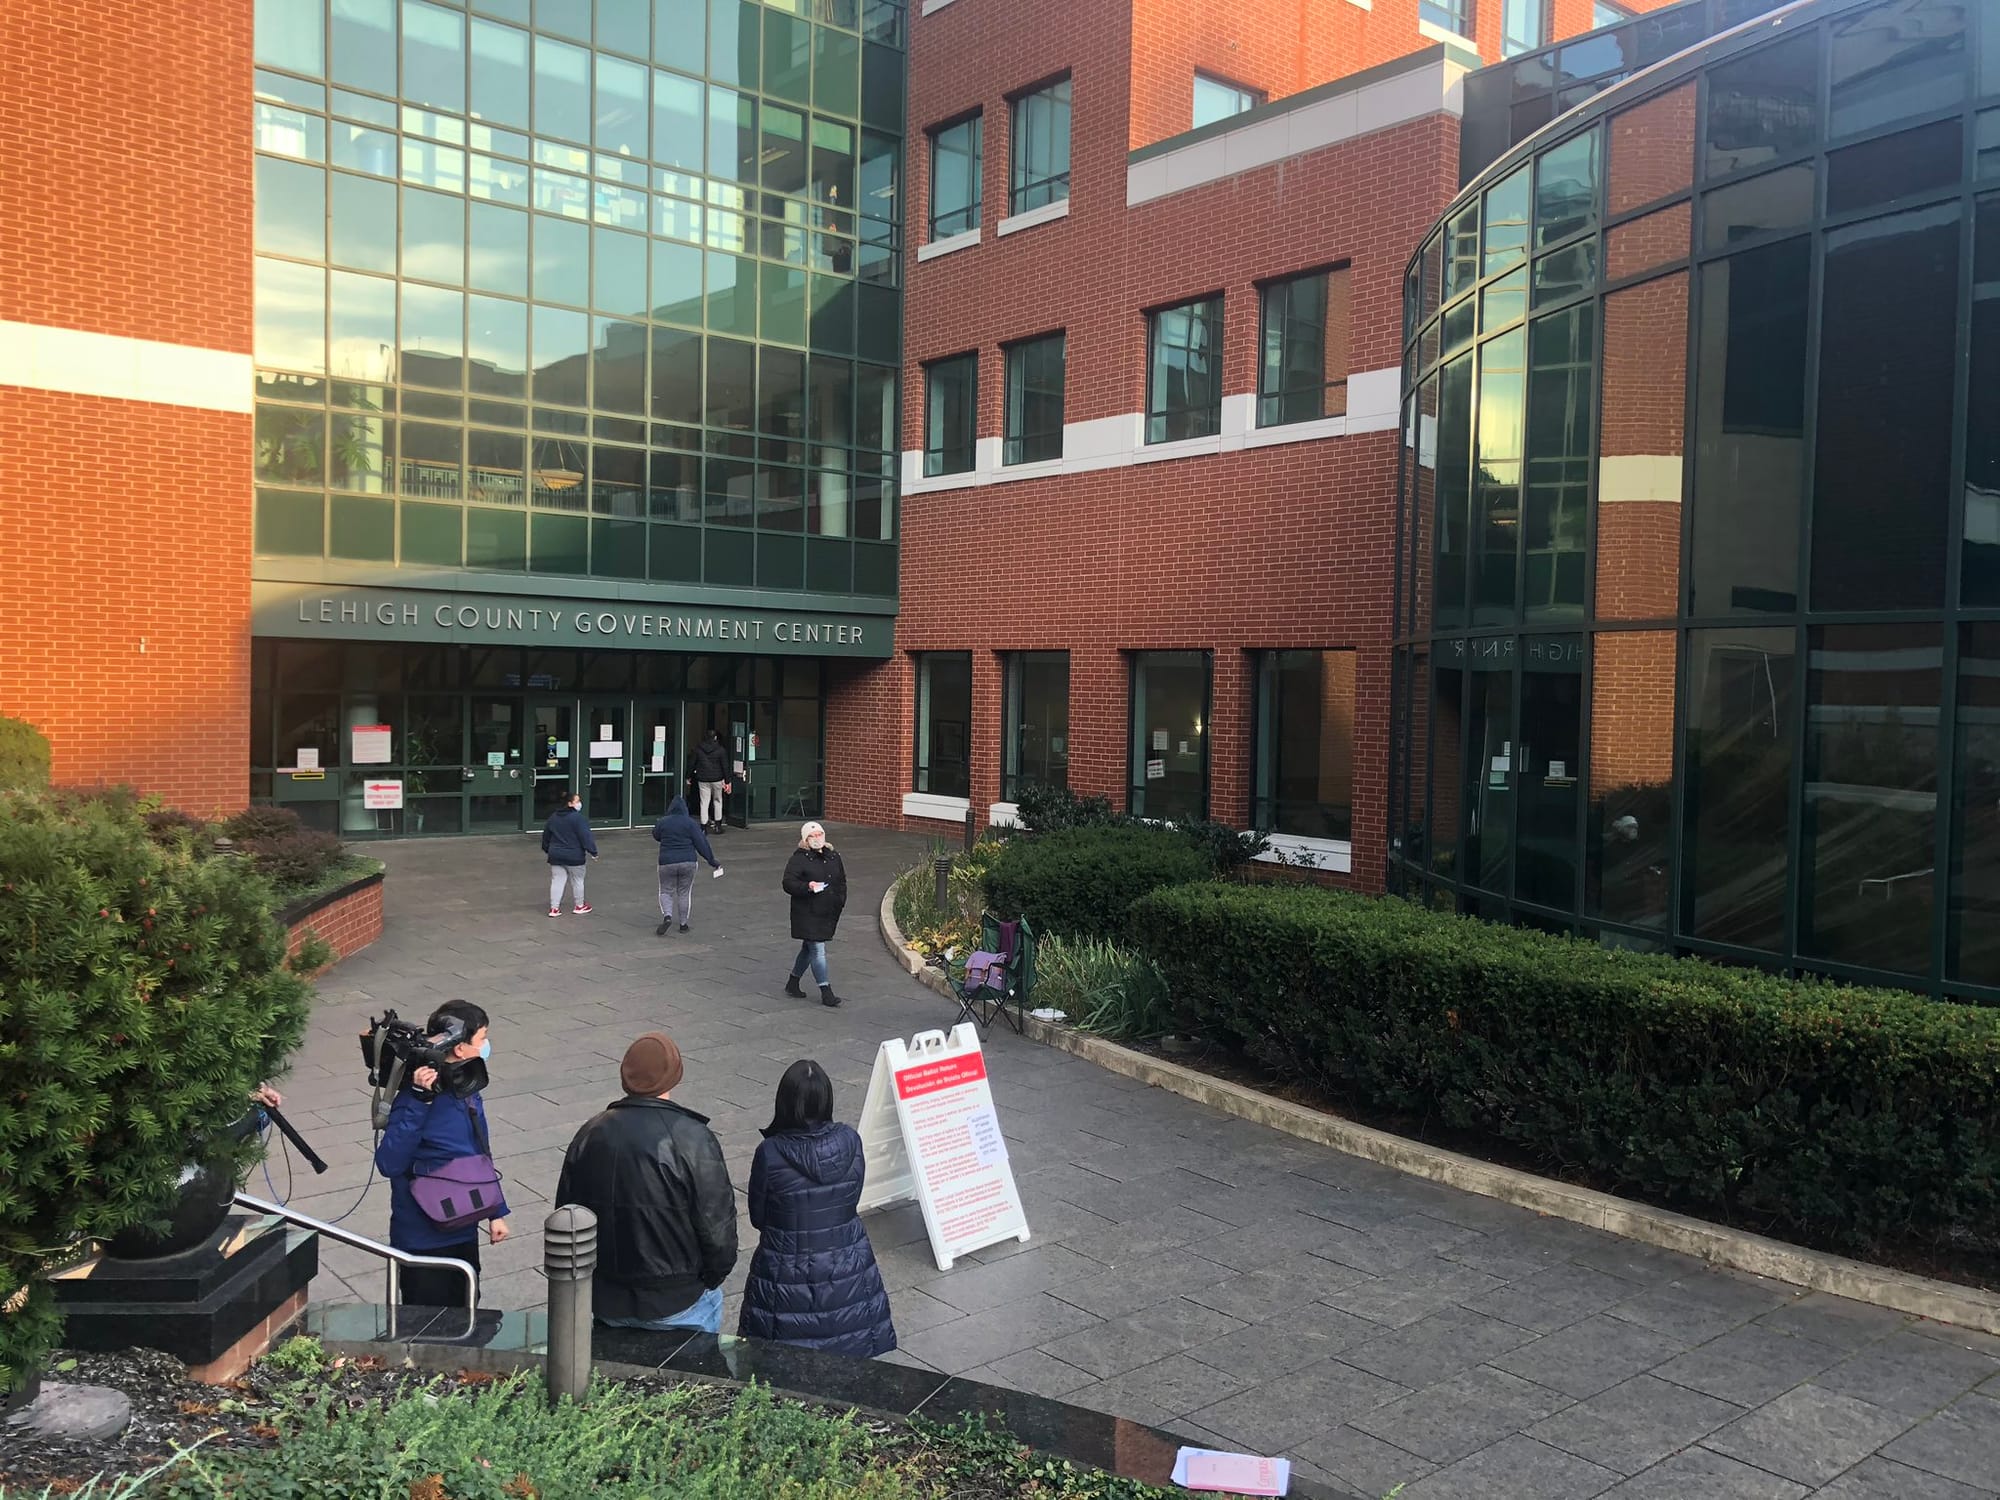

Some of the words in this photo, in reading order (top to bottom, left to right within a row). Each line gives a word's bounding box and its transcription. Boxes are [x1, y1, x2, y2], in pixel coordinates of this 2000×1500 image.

[298, 599, 418, 625] LEHIGH
[434, 604, 562, 631] COUNTY
[574, 612, 764, 640] GOVERNMENT
[774, 622, 864, 644] CENTER
